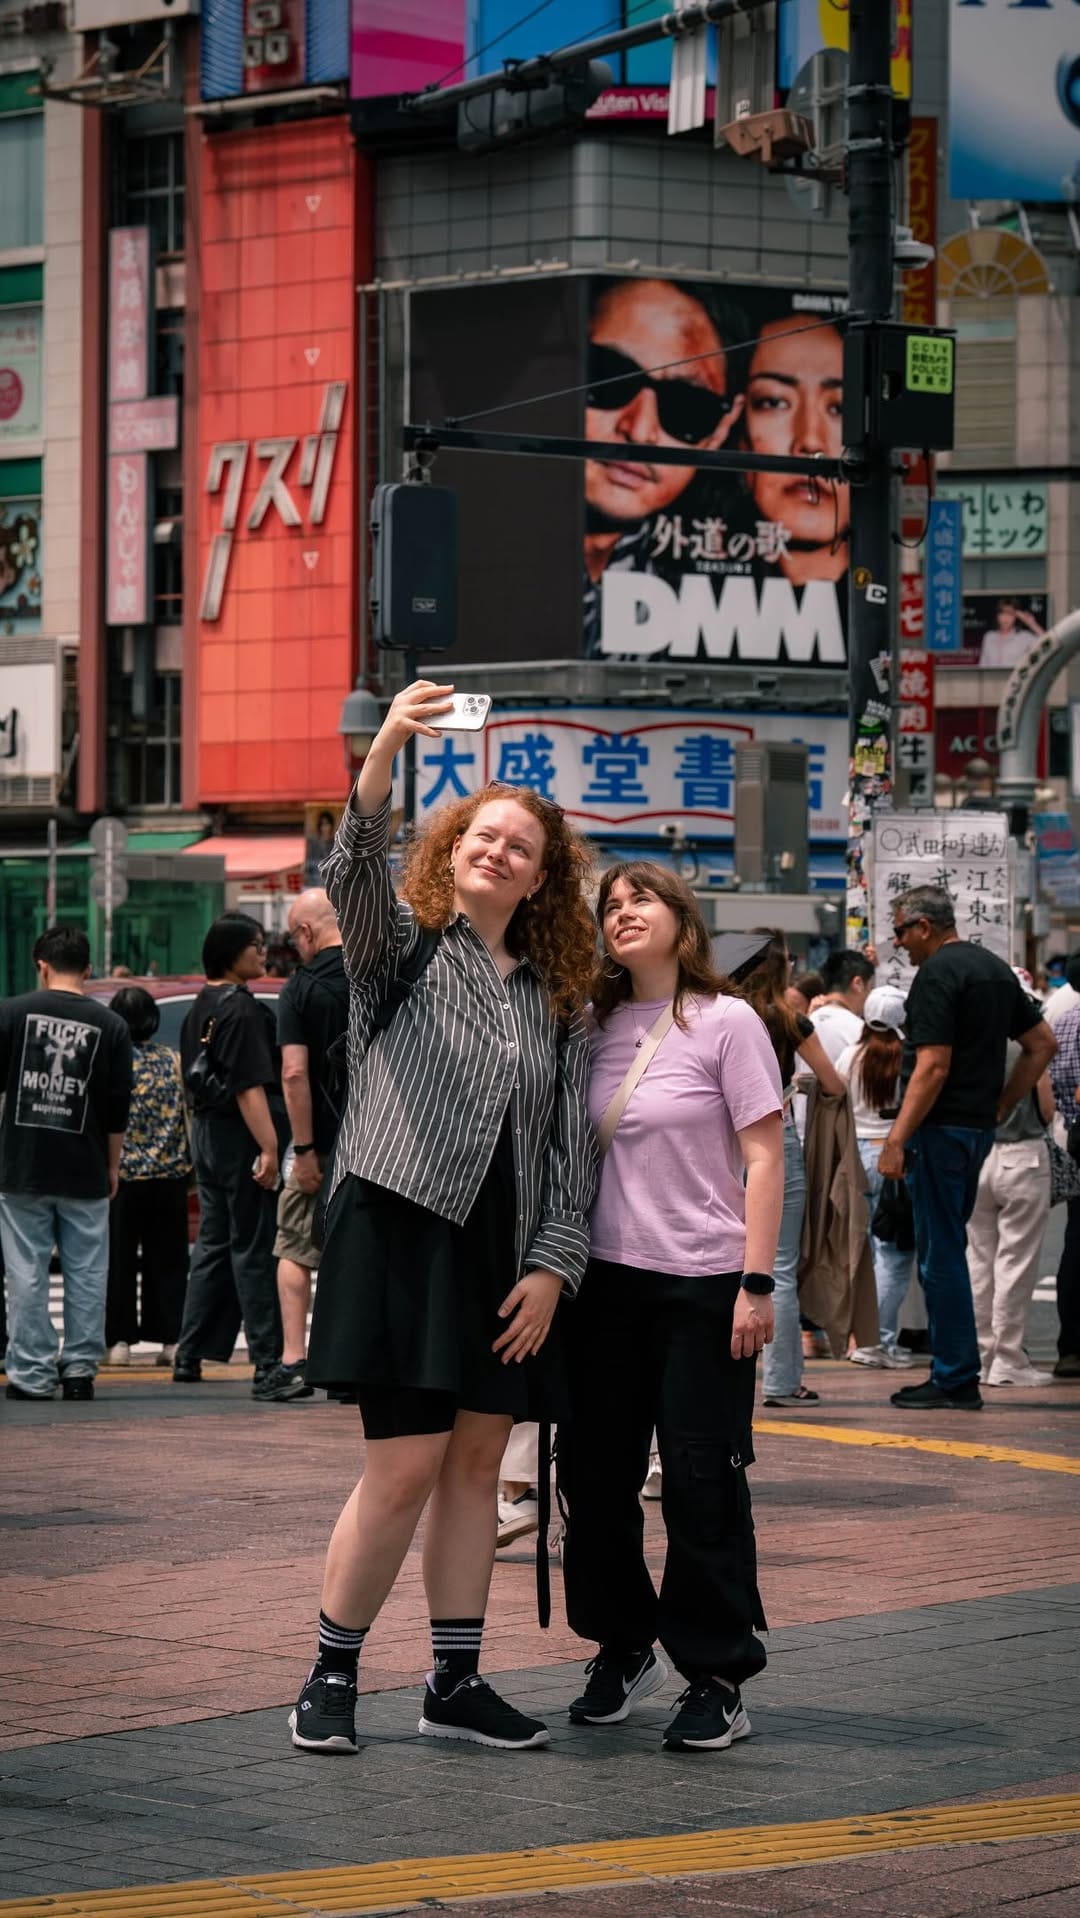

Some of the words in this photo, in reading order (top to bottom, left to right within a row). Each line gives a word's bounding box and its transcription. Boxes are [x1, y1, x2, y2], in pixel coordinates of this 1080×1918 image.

[911, 342, 949, 354] CCTV
[911, 364, 949, 377] POLICE
[200, 381, 347, 621] クスリ
[937, 489, 1045, 516] れいわ
[651, 514, 794, 564] 外道の歌
[602, 571, 847, 663] DMM
[36, 1020, 90, 1047] FUCK
[23, 1070, 87, 1097] MONEY
[32, 1103, 73, 1117] supreme
